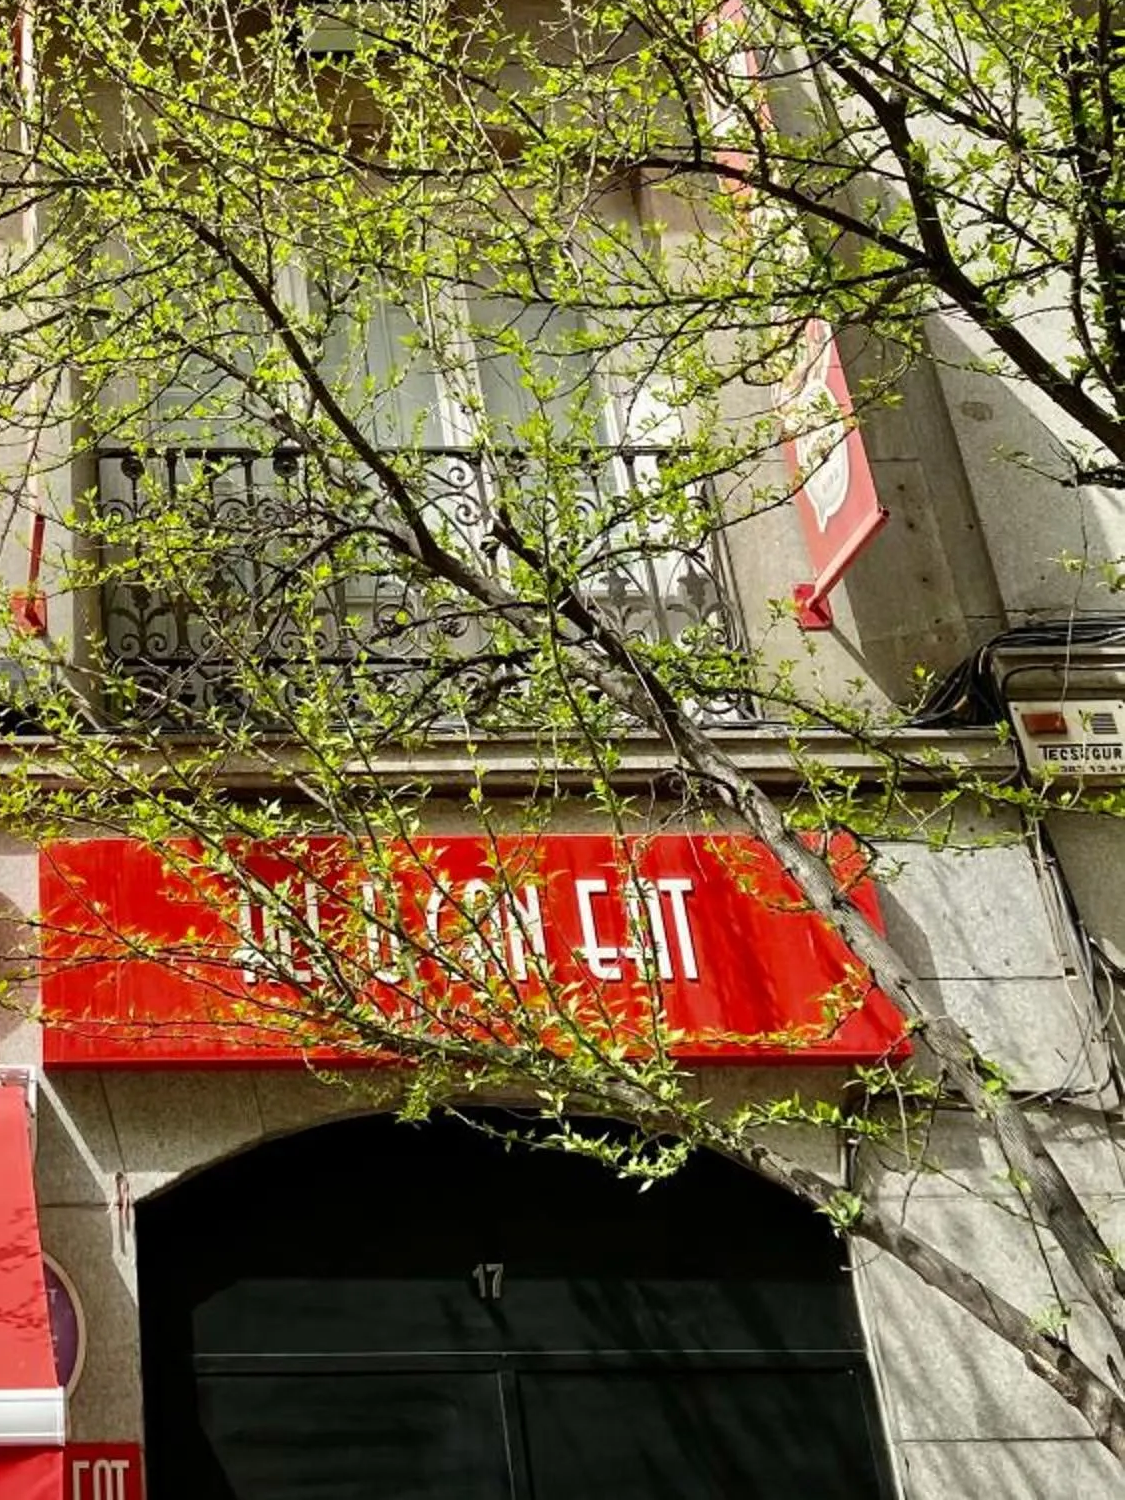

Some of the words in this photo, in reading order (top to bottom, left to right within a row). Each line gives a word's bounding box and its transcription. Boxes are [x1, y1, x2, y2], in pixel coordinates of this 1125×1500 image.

[425, 878, 550, 982] CAN
[572, 877, 699, 980] EAT
[472, 1263, 504, 1299] 17
